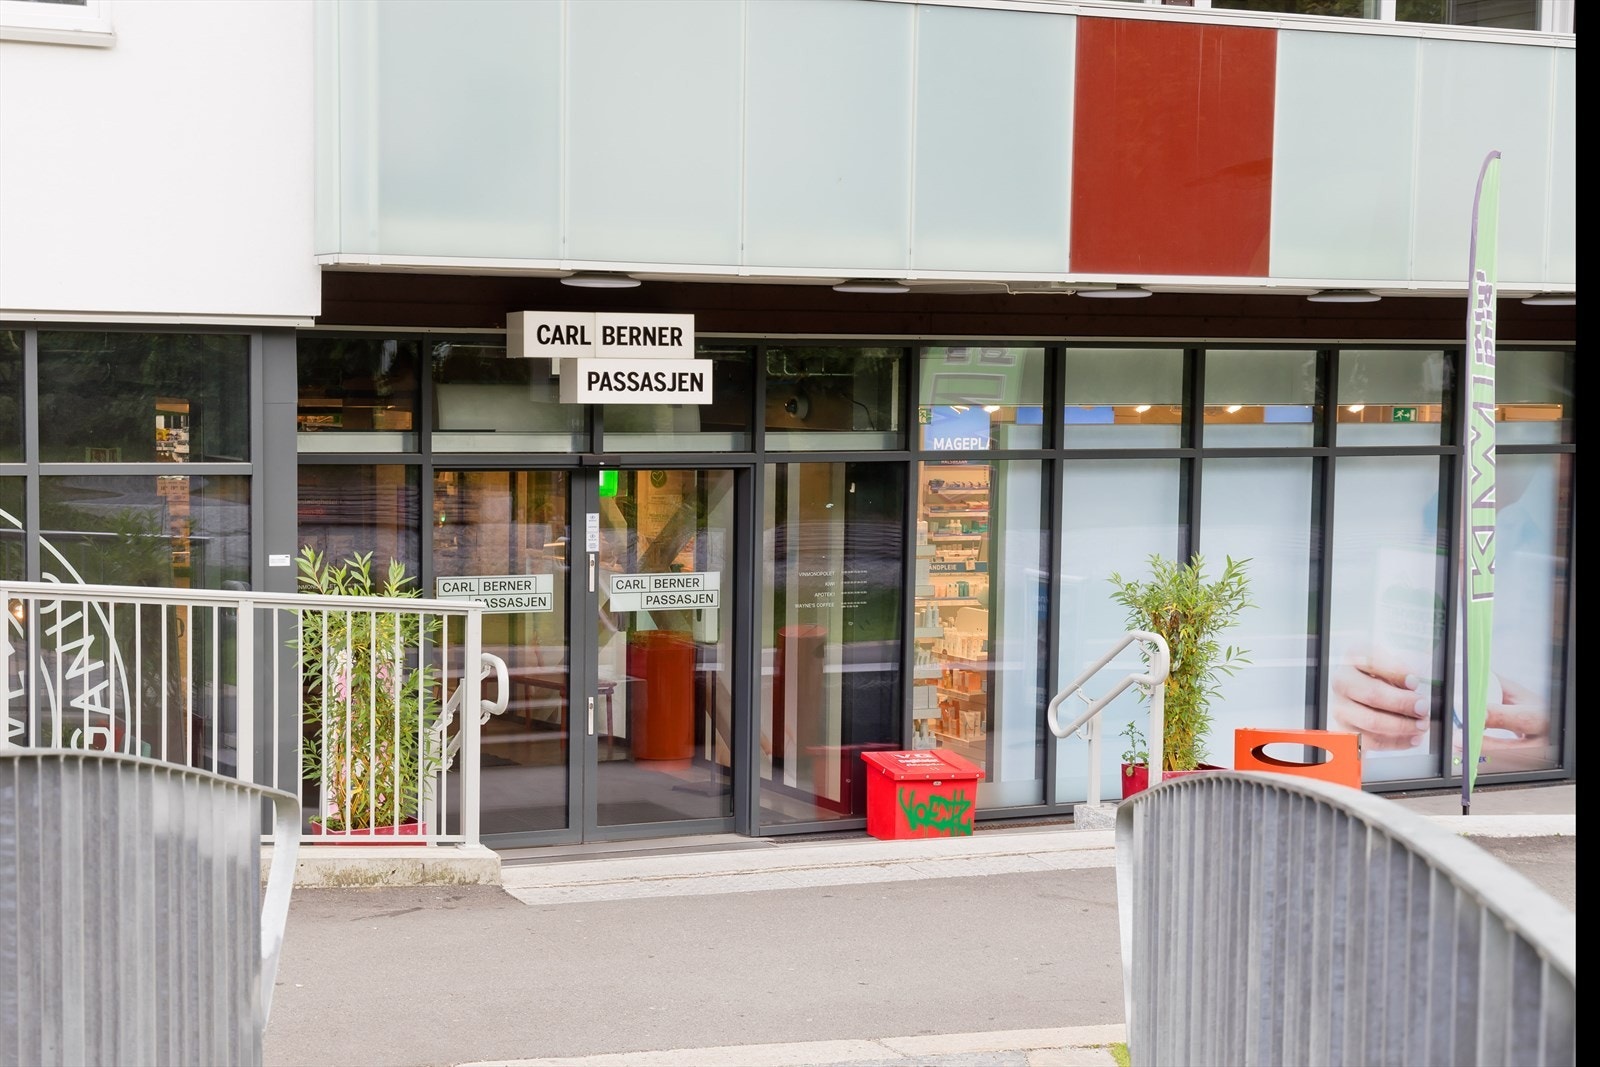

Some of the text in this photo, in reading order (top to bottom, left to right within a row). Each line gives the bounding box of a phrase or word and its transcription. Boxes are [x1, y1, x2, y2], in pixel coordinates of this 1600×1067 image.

[536, 324, 683, 347] CARL BERNER
[586, 371, 704, 393] PASSASJEN
[1472, 374, 1496, 602] KIWI
[441, 579, 533, 593] CARL BERNER
[615, 577, 701, 590] CARL BERNER
[645, 593, 714, 605] PASSASJEN
